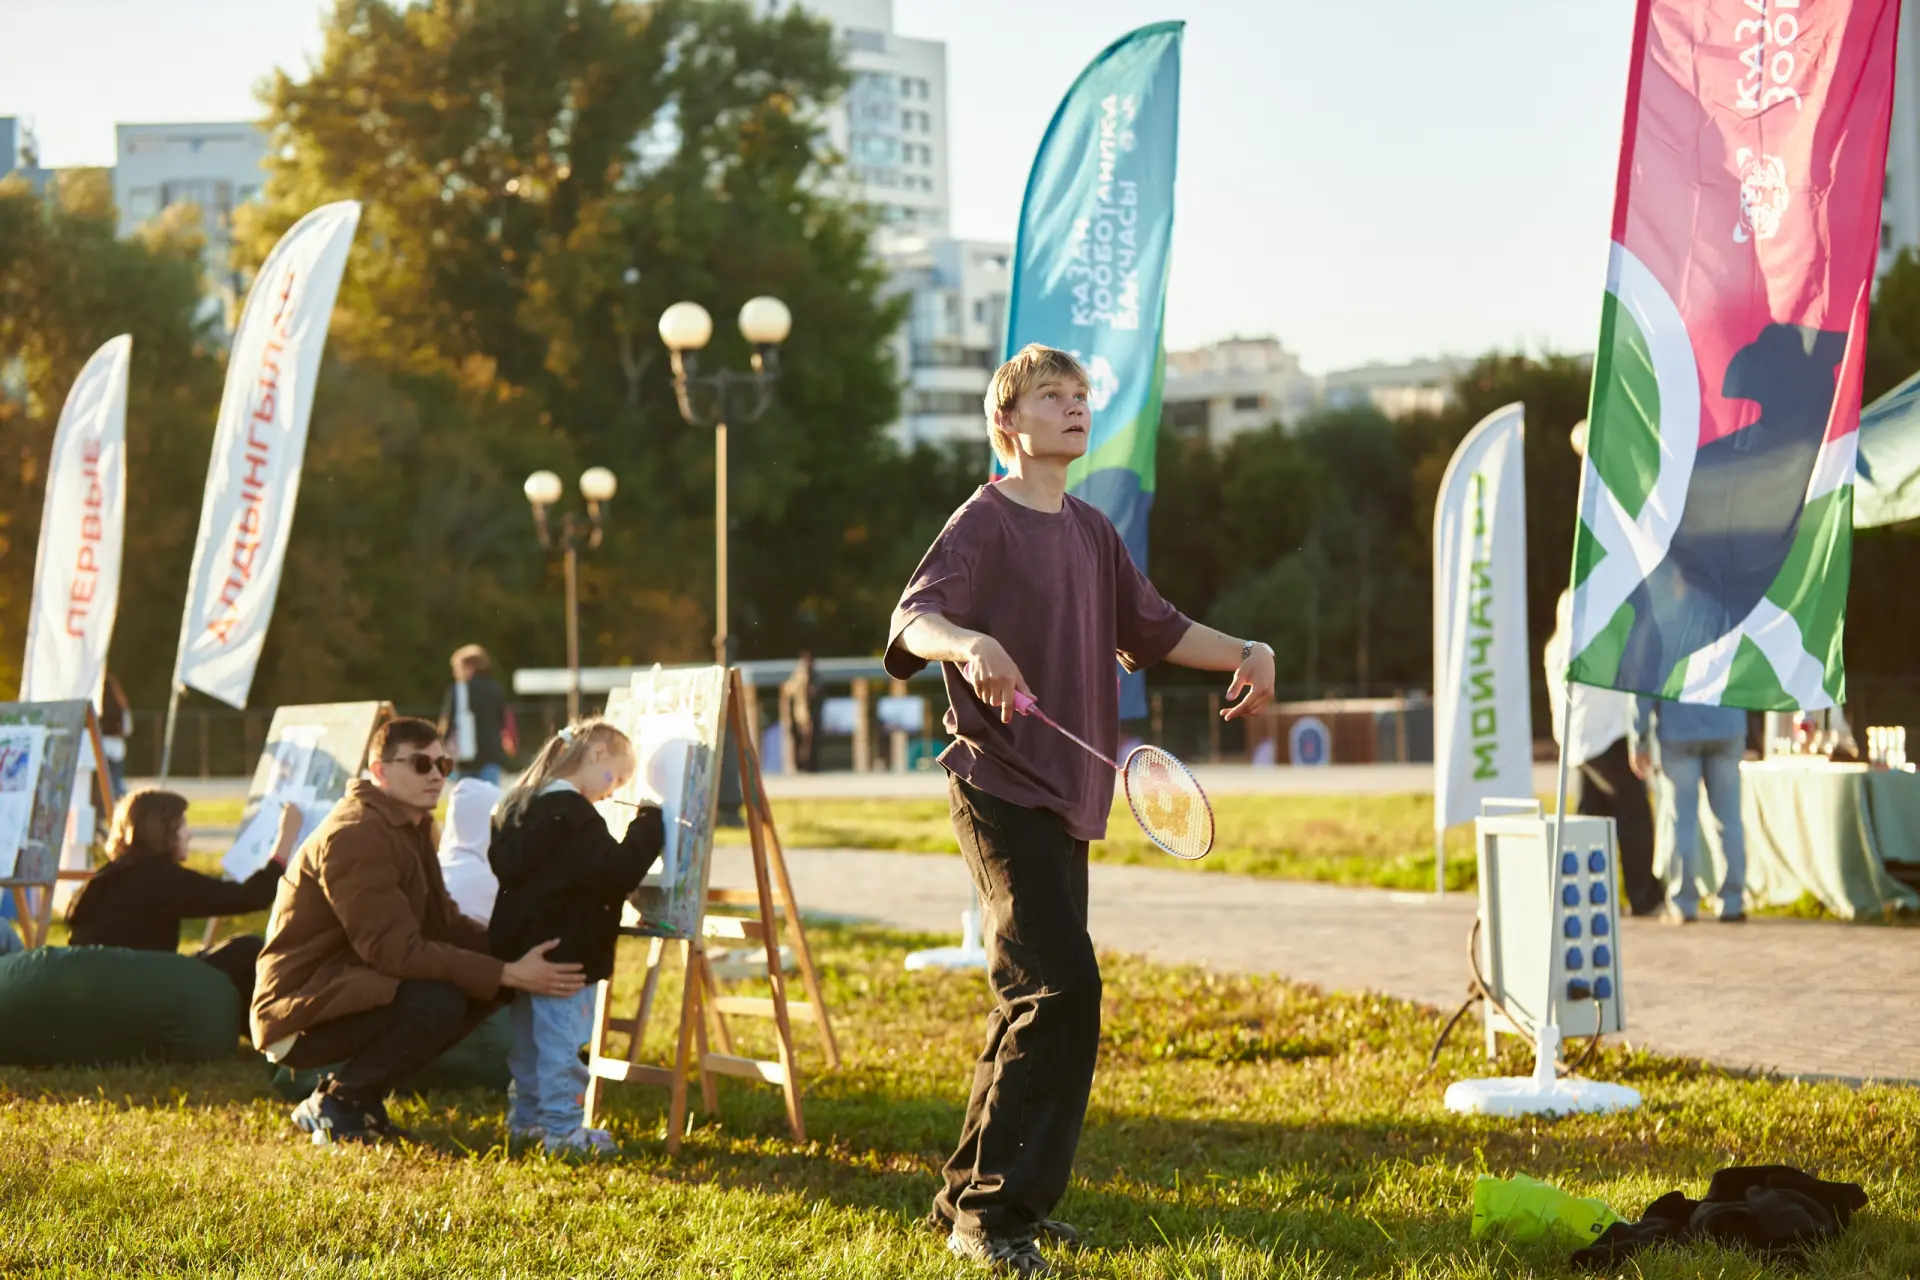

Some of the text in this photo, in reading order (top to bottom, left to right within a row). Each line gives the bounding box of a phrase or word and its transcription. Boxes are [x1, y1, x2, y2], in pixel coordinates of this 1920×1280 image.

[1067, 218, 1095, 326] КАЗАН
[1092, 93, 1119, 322] ЗООБОТАНИКА
[1112, 180, 1139, 330] БАКЧАСЫ
[65, 437, 103, 638] ПЕРВЫЕ
[207, 272, 296, 645] АЛДЫНГЫЛ
